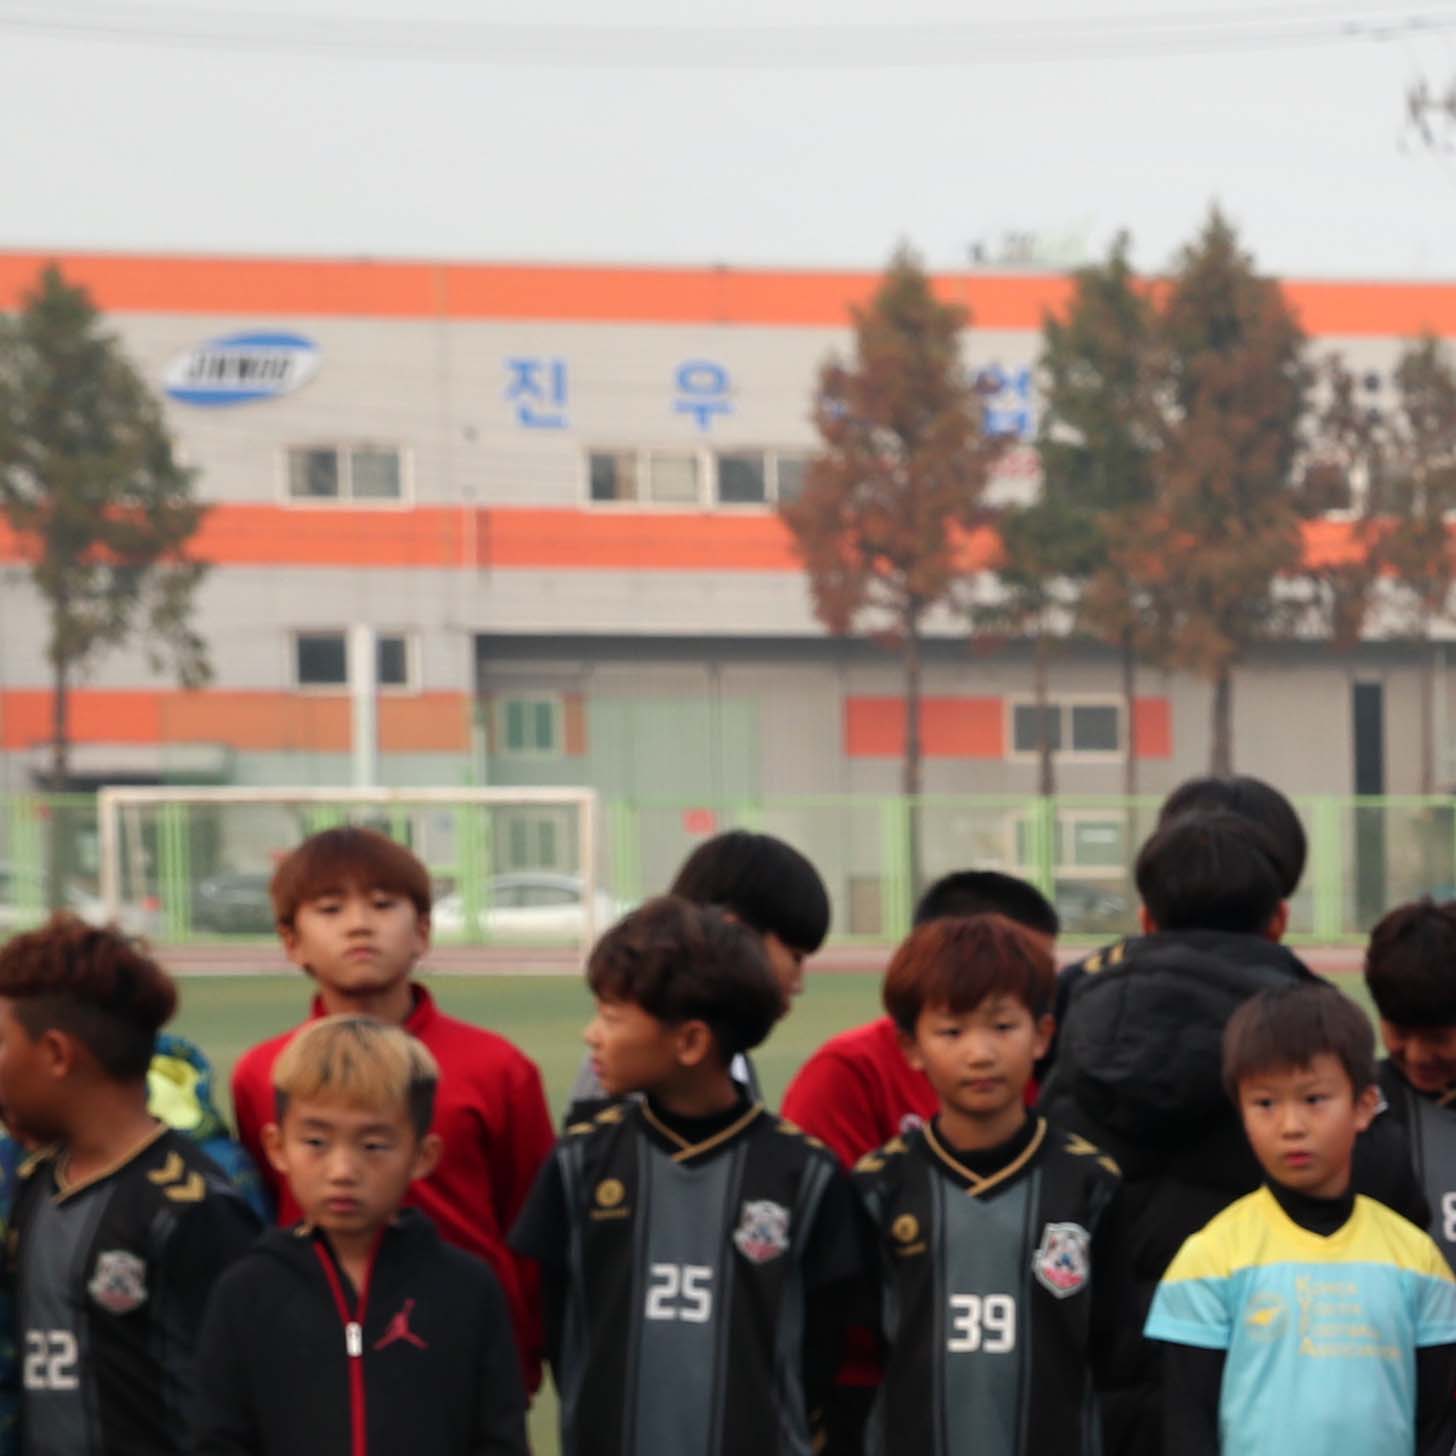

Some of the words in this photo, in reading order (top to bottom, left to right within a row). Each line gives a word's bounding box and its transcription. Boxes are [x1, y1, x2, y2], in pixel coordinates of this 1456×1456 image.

[645, 1264, 713, 1323] 25
[947, 1293, 1016, 1353] 39
[23, 1330, 80, 1391] 22
